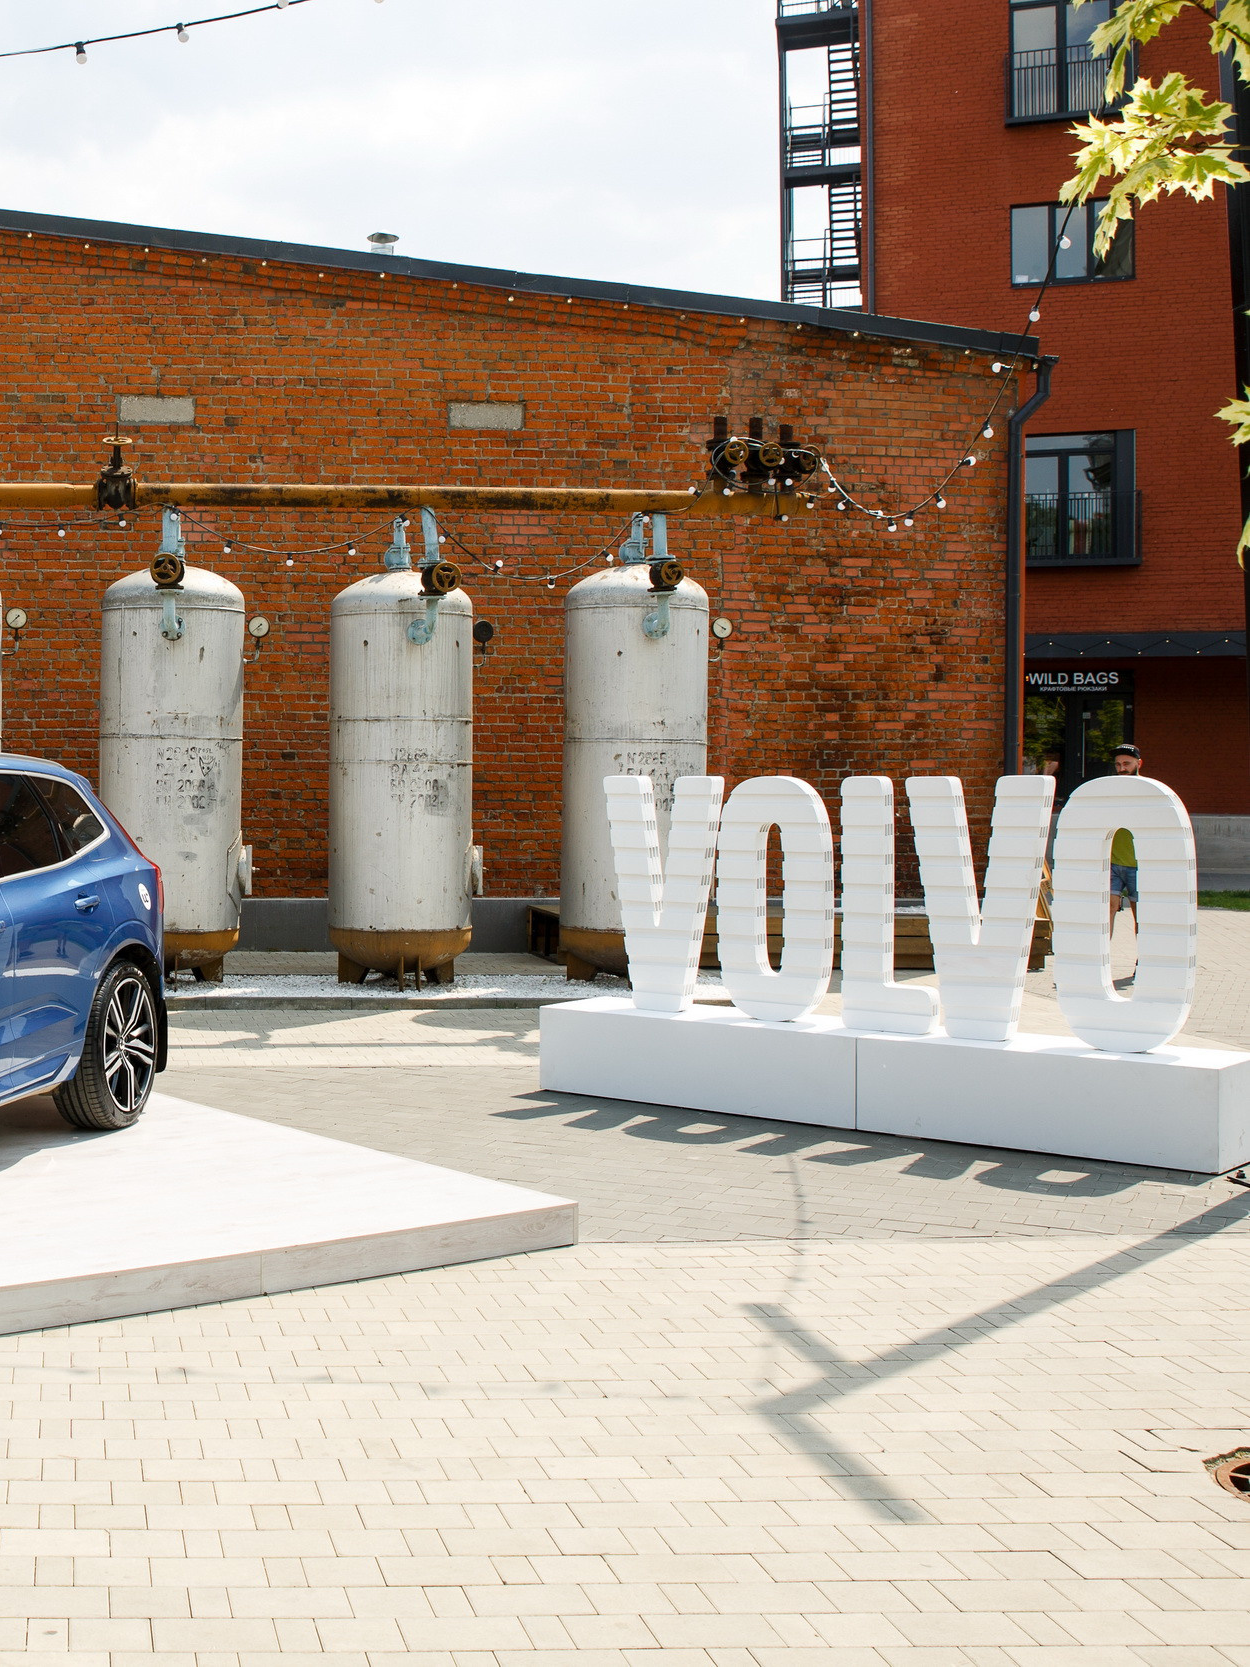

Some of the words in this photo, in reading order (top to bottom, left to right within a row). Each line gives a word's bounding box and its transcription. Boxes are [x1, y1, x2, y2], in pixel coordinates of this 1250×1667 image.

[1029, 672, 1069, 685] WILD
[1073, 671, 1119, 685] BAGS
[603, 775, 1197, 1052] VOLVO
